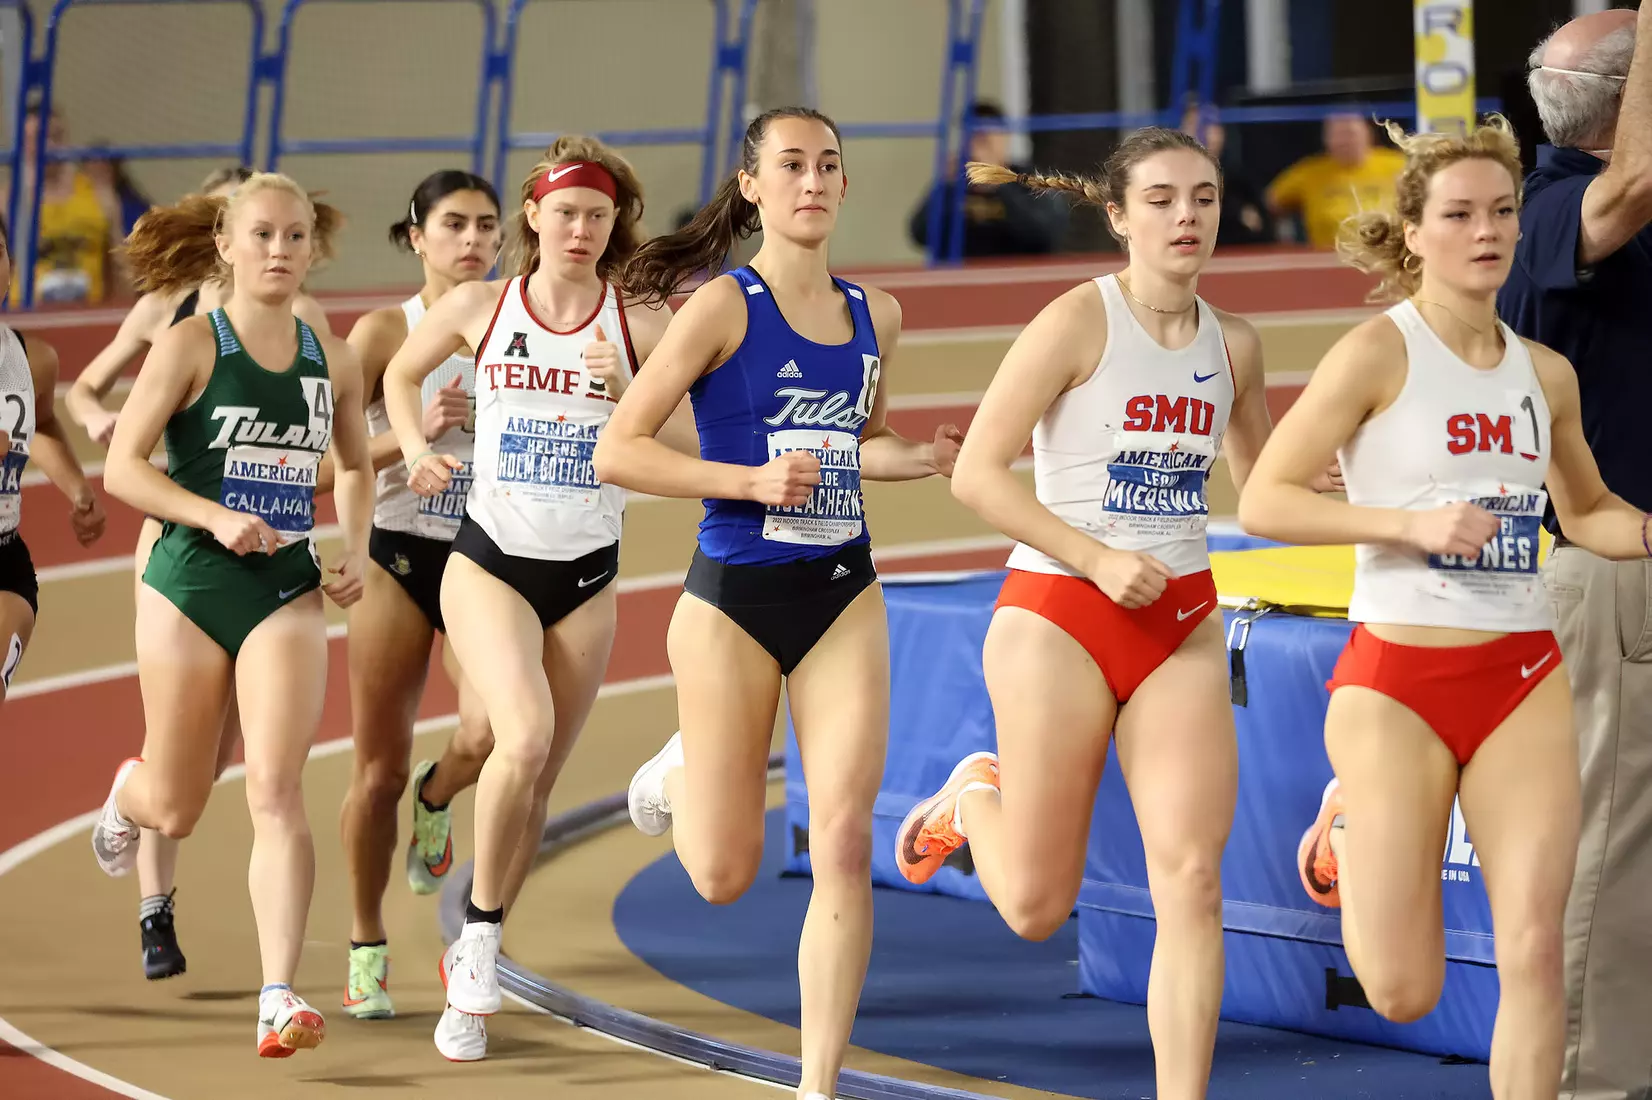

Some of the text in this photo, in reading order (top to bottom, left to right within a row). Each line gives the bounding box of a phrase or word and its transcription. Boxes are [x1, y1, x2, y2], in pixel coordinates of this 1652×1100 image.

[485, 363, 618, 404] TEMP
[776, 371, 803, 379] adidas
[864, 360, 878, 414] 6
[5, 394, 27, 440] 2
[314, 383, 330, 430] 4
[1122, 394, 1215, 436] SMU
[1520, 395, 1541, 453] 1
[506, 416, 600, 440] AMERICAN
[1447, 413, 1540, 462] SM
[527, 438, 579, 457] HELENE
[1112, 450, 1208, 469] AMERICAN
[229, 460, 313, 484] AMERICAN
[499, 451, 536, 480] HOLM
[225, 491, 311, 518] CALLAHAN
